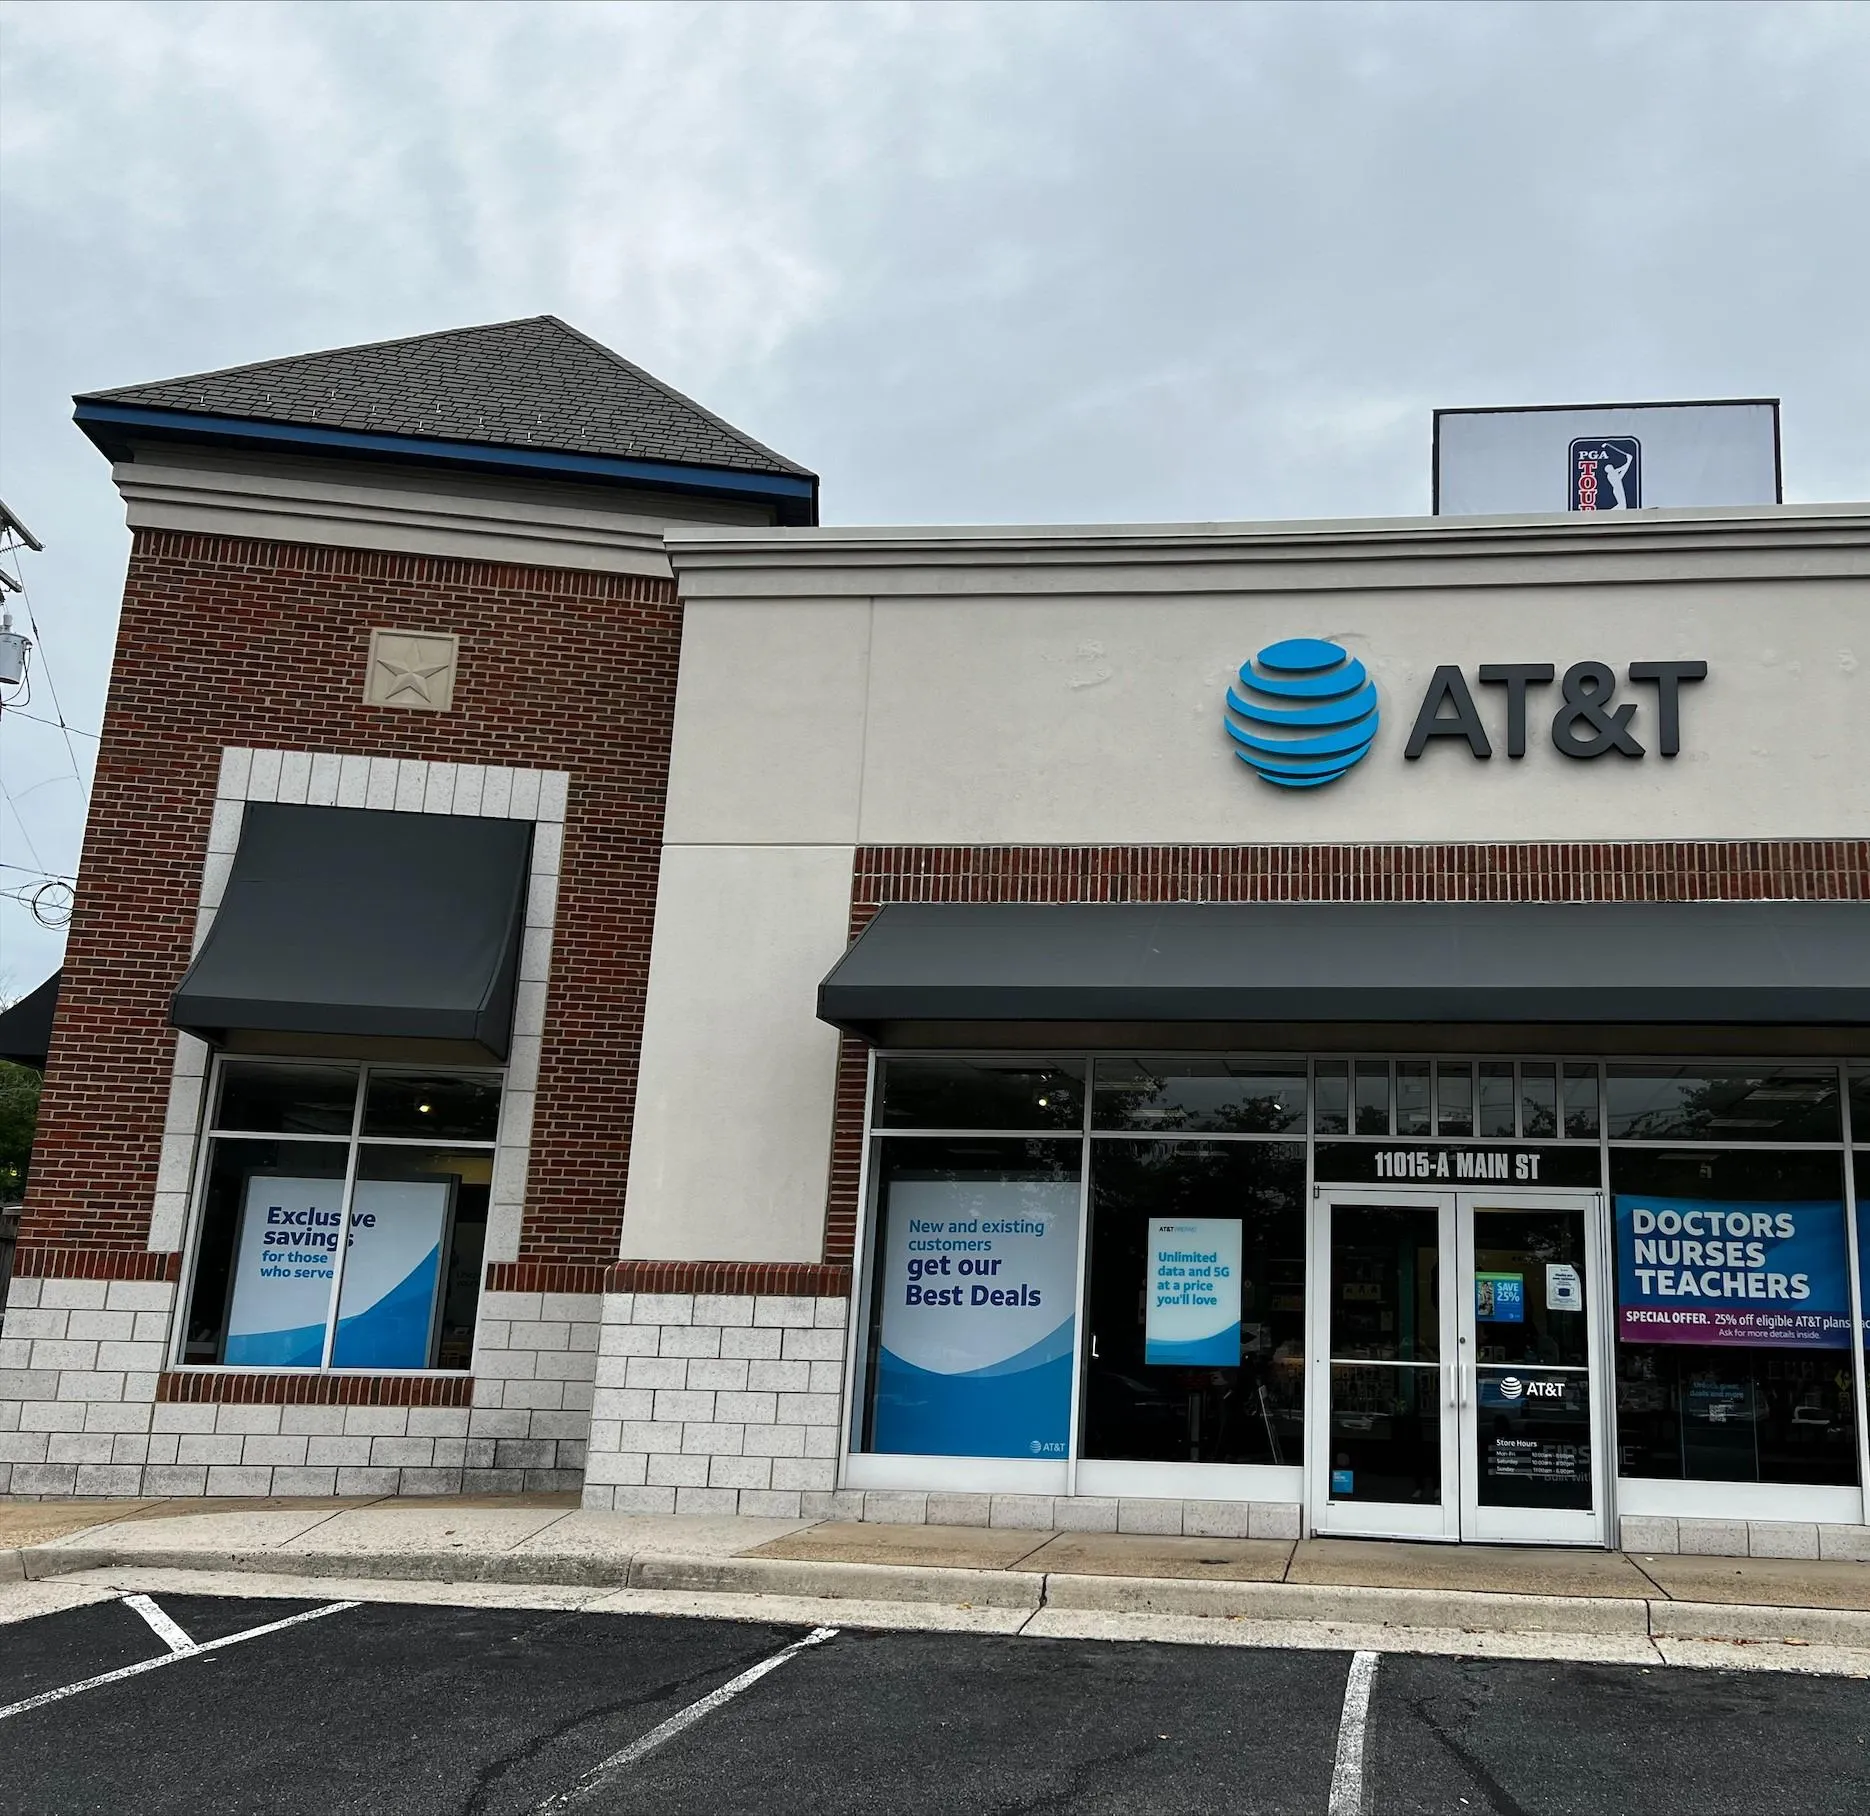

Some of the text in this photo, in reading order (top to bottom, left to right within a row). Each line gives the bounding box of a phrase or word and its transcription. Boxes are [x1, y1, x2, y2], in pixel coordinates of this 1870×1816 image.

[1578, 450, 1609, 460] PGA
[1404, 660, 1708, 759] AT&T
[1375, 1152, 1541, 1180] 11015-A MAIN ST
[267, 1206, 376, 1228] Exclusve
[1632, 1209, 1796, 1239] DOCTORS
[909, 1219, 1045, 1237] New and existing
[908, 1238, 992, 1251] customers
[262, 1250, 328, 1264] for those
[1158, 1251, 1217, 1263] Unlimited
[1634, 1239, 1766, 1268] NURSES
[260, 1265, 334, 1279] who serve
[907, 1256, 1002, 1282] get our
[1158, 1265, 1230, 1277] data and 5G
[1157, 1280, 1214, 1294] at a price
[1496, 1282, 1519, 1292] SAVE
[1634, 1269, 1811, 1300] TEACHERS
[905, 1283, 1042, 1306] Best Deals
[1156, 1293, 1218, 1307] you'll love
[1496, 1291, 1521, 1303] 25%
[1626, 1310, 1671, 1323] SPECIAL
[1672, 1312, 1710, 1325] OFFER.
[1714, 1314, 1738, 1325] 25%
[1738, 1313, 1754, 1326] off
[1756, 1315, 1793, 1330] eligible
[1795, 1315, 1822, 1328] AT&T
[1823, 1315, 1851, 1331] plans
[1719, 1329, 1734, 1337] Ask
[1734, 1329, 1747, 1337] for
[1769, 1330, 1796, 1339] details
[1526, 1382, 1565, 1397] AT&T
[1042, 1442, 1066, 1453] AT&T
[1496, 1439, 1538, 1448] Store Hours
